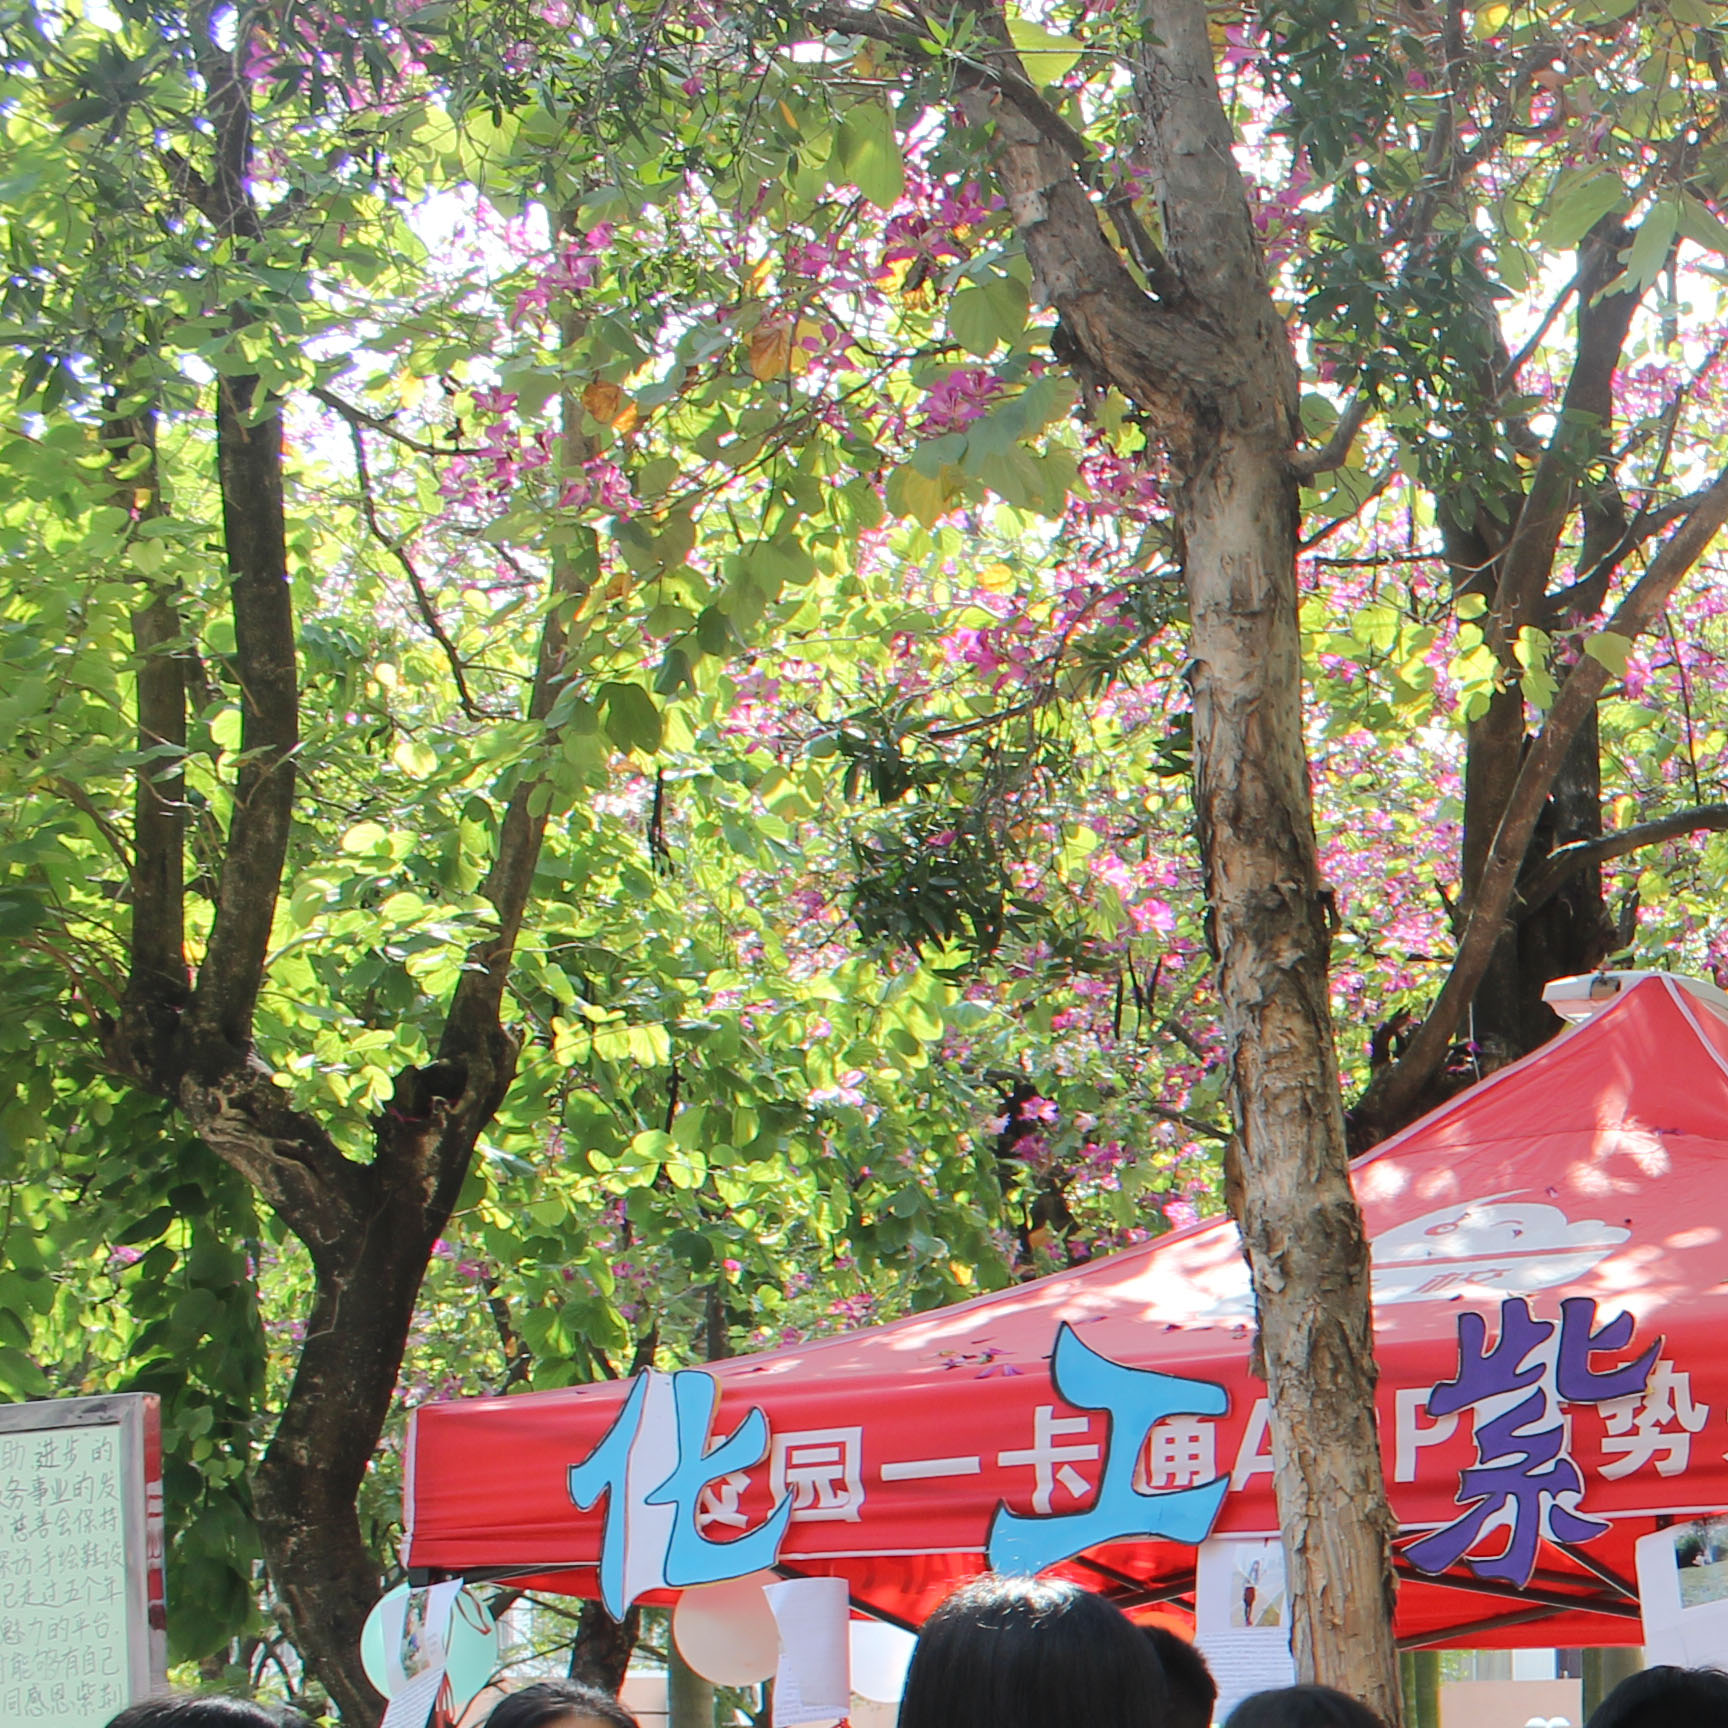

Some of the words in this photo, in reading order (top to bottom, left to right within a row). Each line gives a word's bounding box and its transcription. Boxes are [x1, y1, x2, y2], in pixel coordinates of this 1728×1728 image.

[568, 1366, 793, 1623] 化
[986, 1320, 1231, 1577] 工
[1402, 1295, 1664, 1589] 紫
